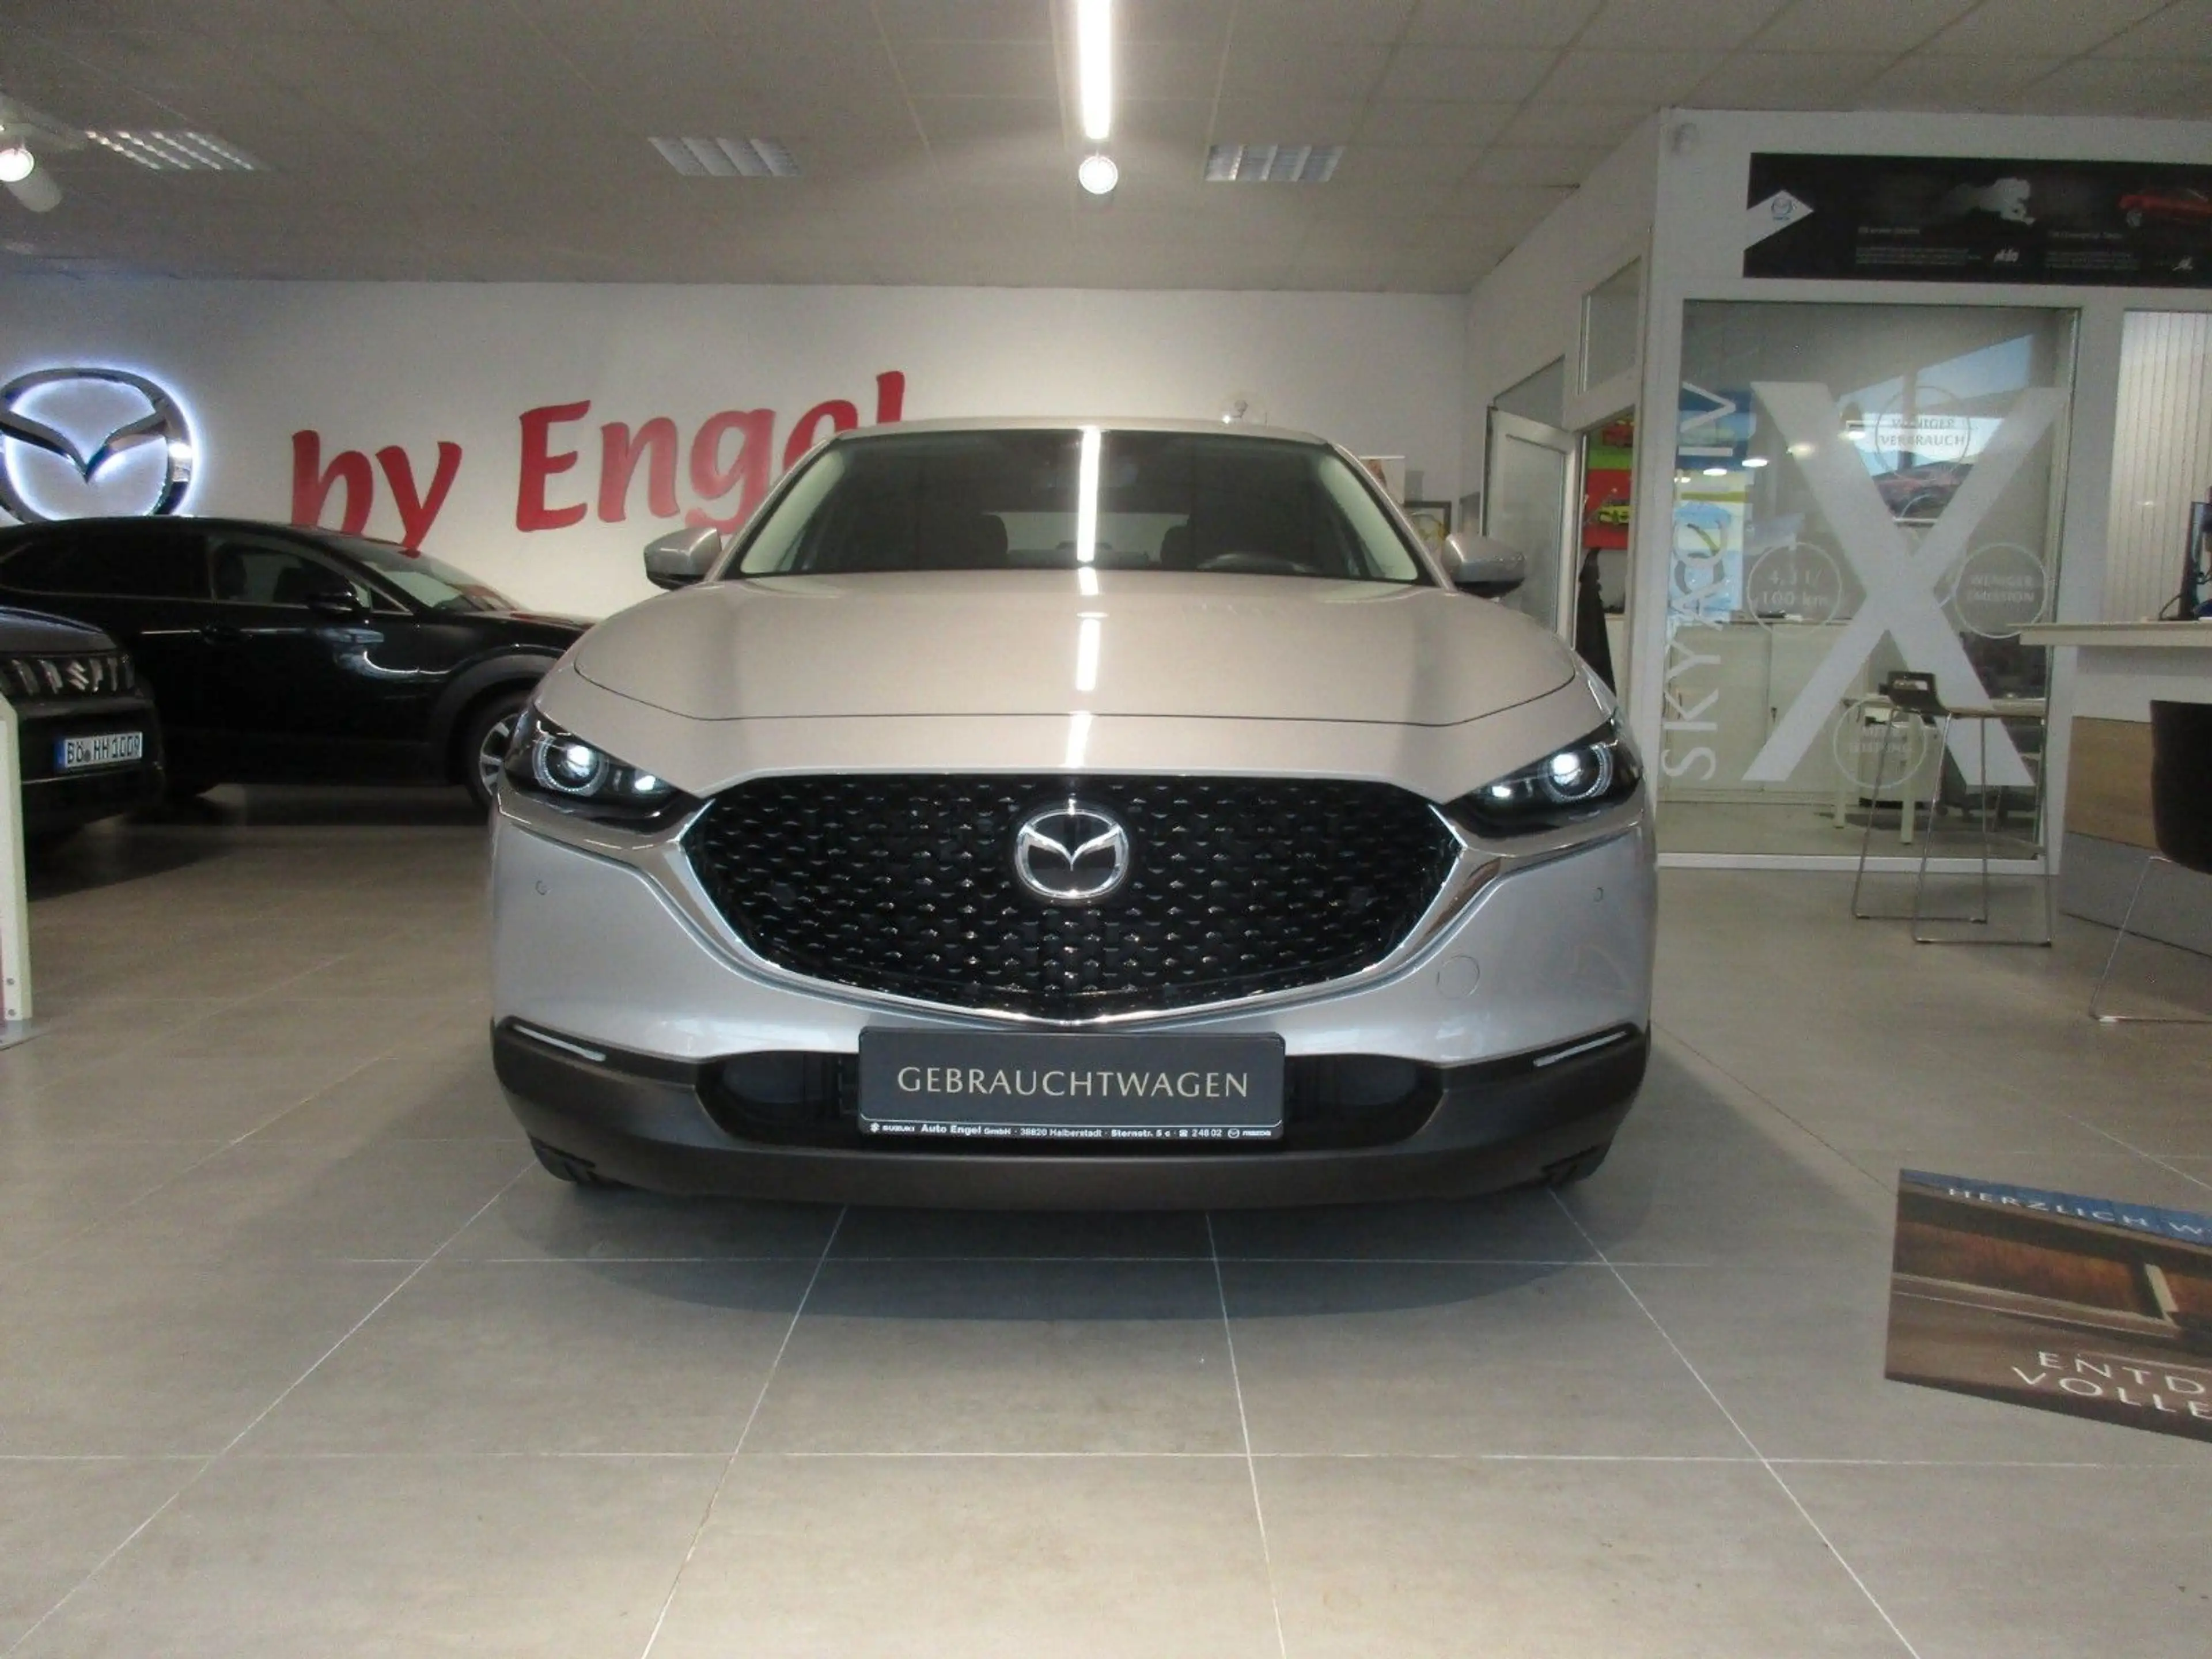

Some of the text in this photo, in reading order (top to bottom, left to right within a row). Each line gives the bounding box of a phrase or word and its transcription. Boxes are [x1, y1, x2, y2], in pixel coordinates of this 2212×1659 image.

[1880, 435, 1964, 446] VERBRAUCH
[897, 1066, 1248, 1098] GEBRAUCHTWAGEN
[921, 1123, 948, 1134] Auto
[950, 1124, 982, 1136] Engel
[984, 1128, 1012, 1136] GmbH
[1050, 1128, 1103, 1138] Halberstadt
[1111, 1129, 1153, 1138] Sternstr.
[1948, 1188, 2149, 1227] HERZLICH
